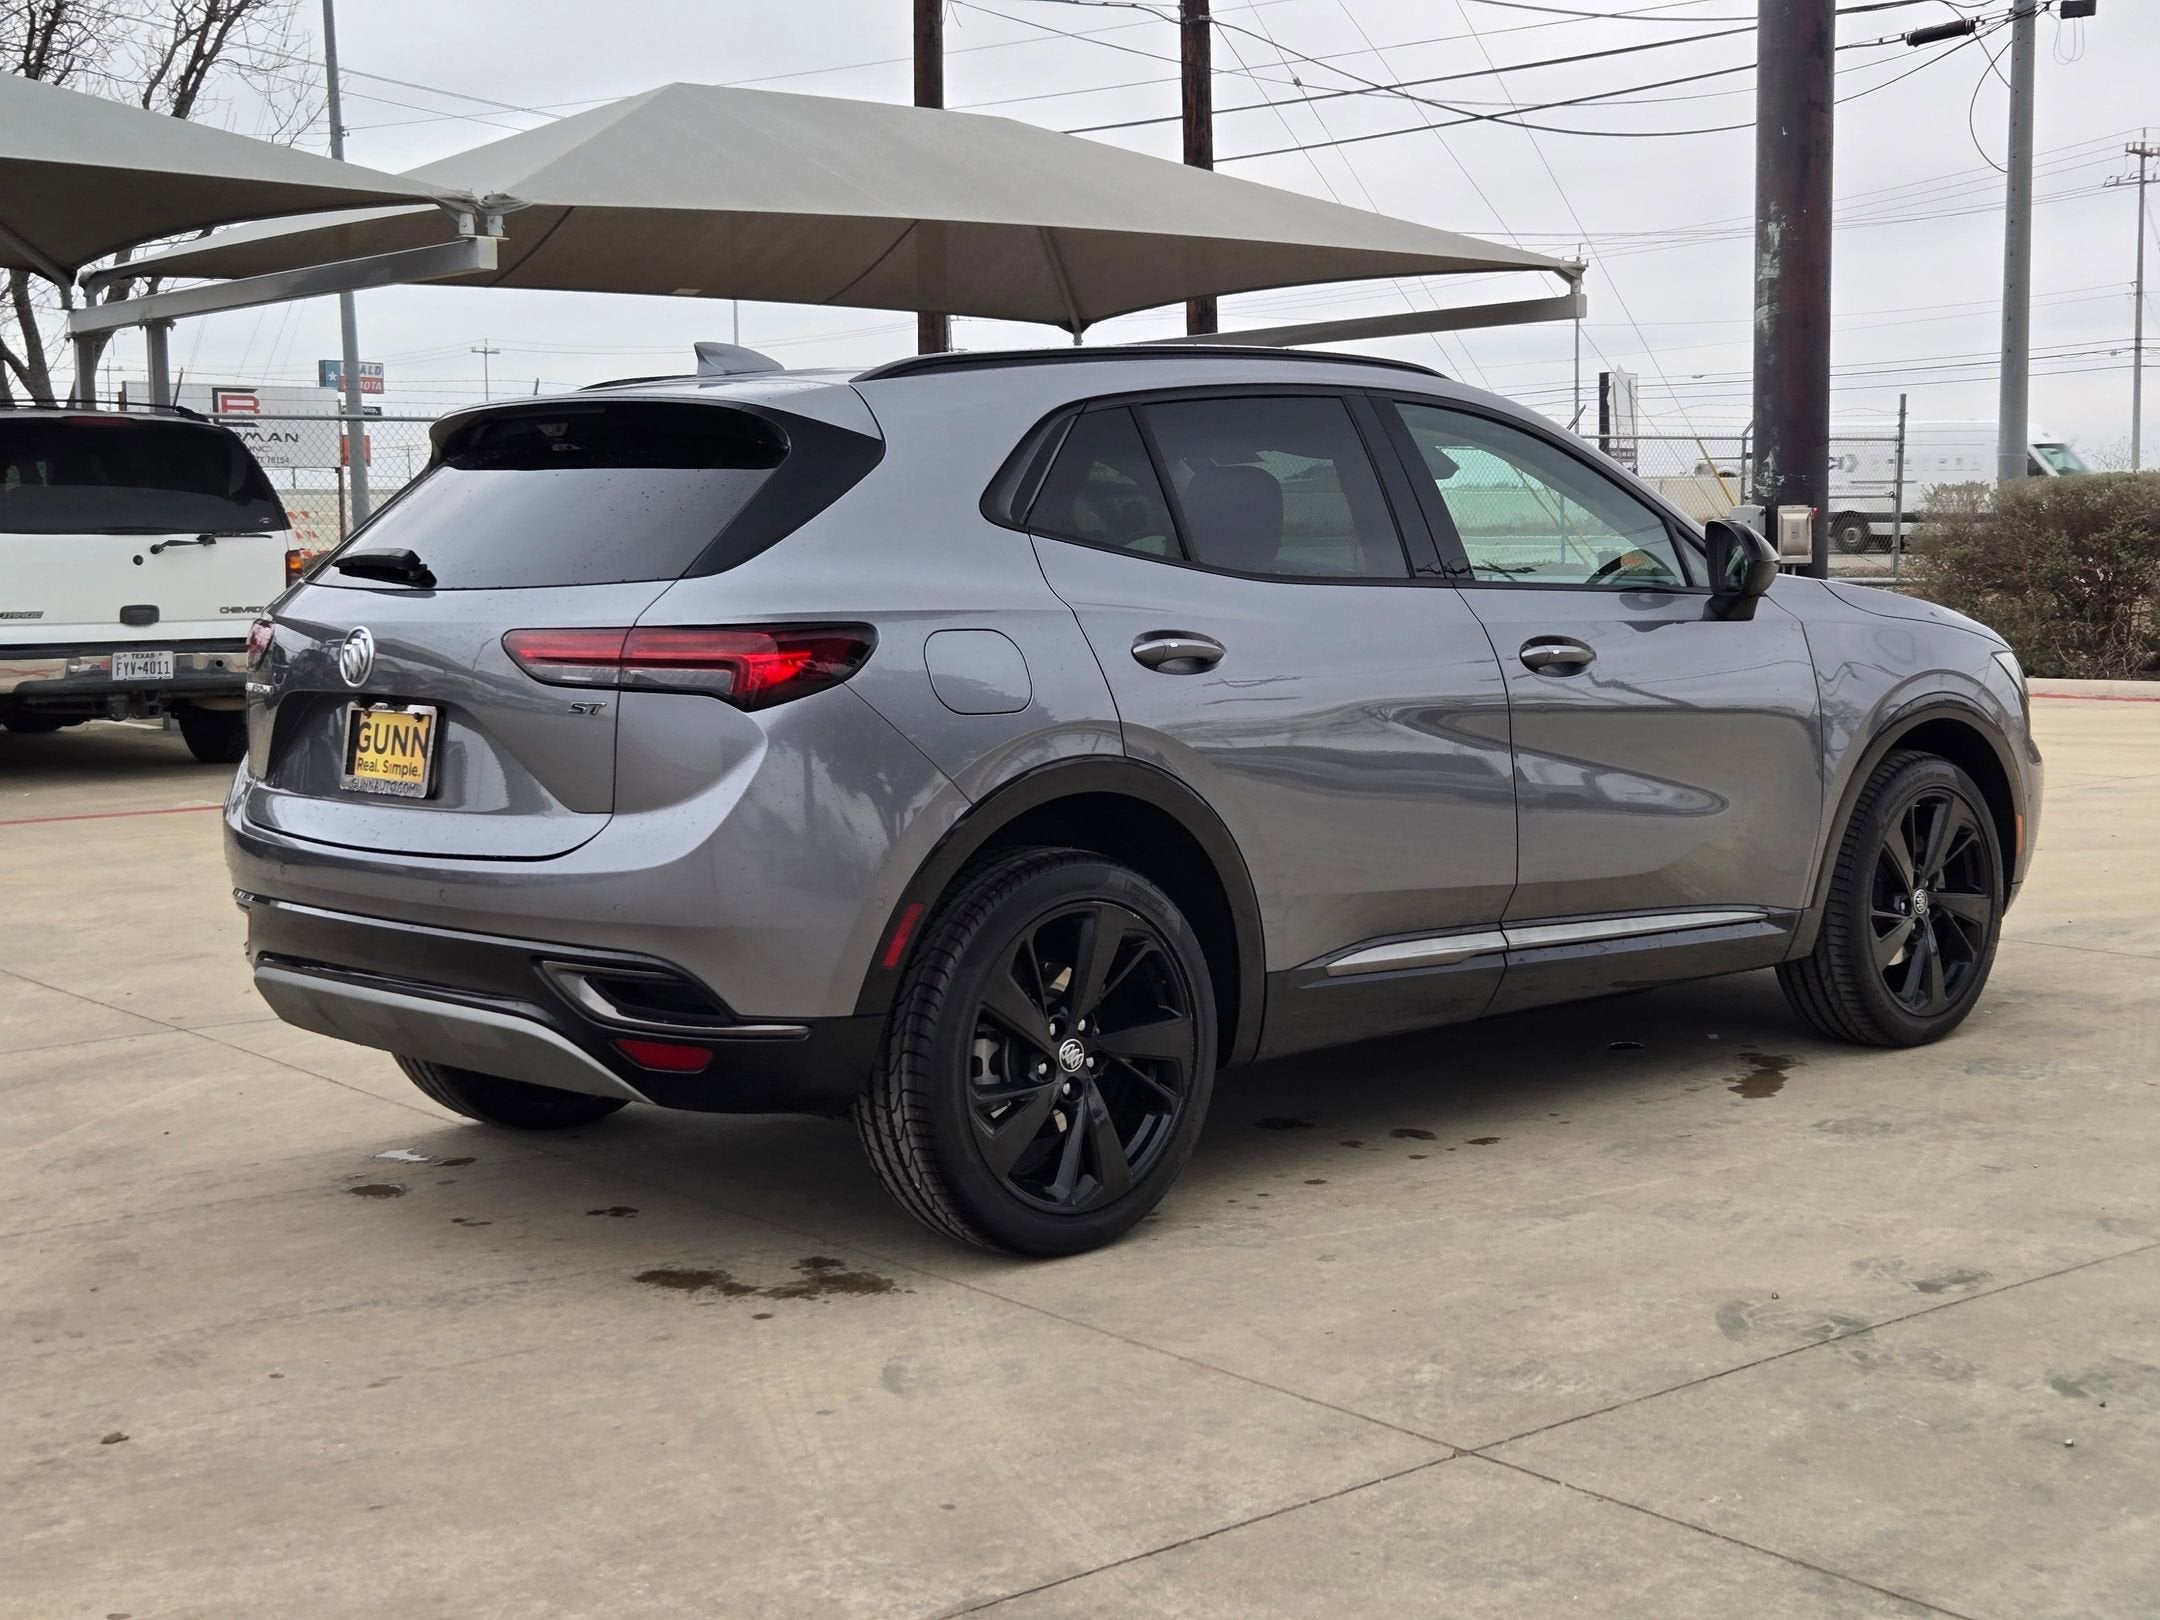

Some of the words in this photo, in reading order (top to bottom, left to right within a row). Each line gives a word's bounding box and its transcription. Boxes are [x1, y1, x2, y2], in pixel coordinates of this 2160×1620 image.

[219, 606, 264, 614] CHEVRO
[131, 652, 155, 660] TEXAS
[567, 701, 607, 715] ST
[358, 721, 429, 760] GUNN
[356, 757, 380, 773] Real.
[382, 759, 421, 779] Simple.
